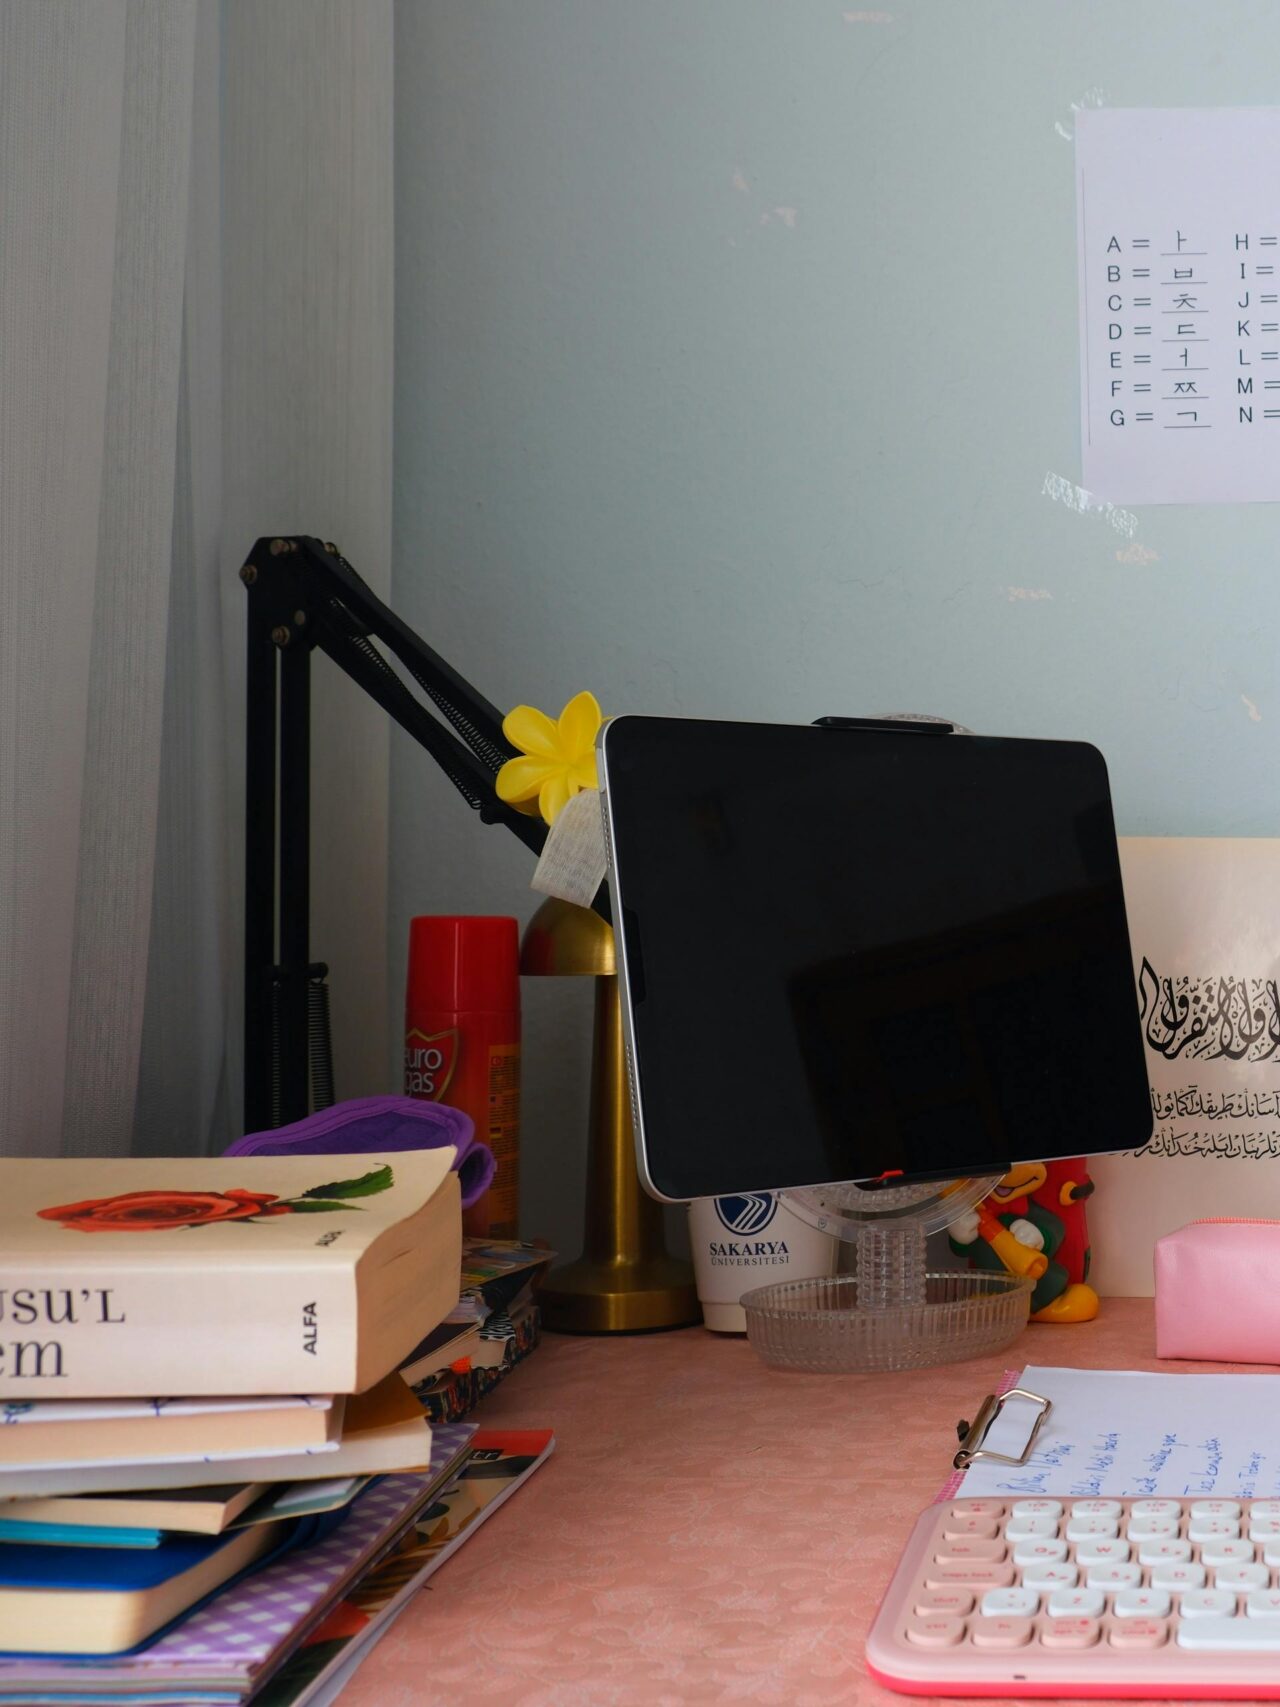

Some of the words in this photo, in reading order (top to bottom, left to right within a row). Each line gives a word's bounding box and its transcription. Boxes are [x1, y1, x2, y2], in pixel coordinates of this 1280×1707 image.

[1106, 235, 1122, 254] A
[1235, 232, 1249, 251] H
[1107, 264, 1122, 283] B
[1240, 262, 1246, 280] I
[1107, 294, 1123, 312] C
[1237, 291, 1250, 309] J
[1108, 323, 1123, 341] D
[1237, 319, 1251, 337] K
[1109, 351, 1123, 369] E
[1238, 348, 1252, 366] L
[1111, 379, 1124, 398] F
[1237, 376, 1254, 395] M
[1109, 408, 1126, 427] G
[1239, 405, 1253, 424] N
[709, 1241, 789, 1256] SAKARYA
[711, 1255, 789, 1266] ÜNİVERSİTESİ
[303, 1302, 317, 1355] ALFA
